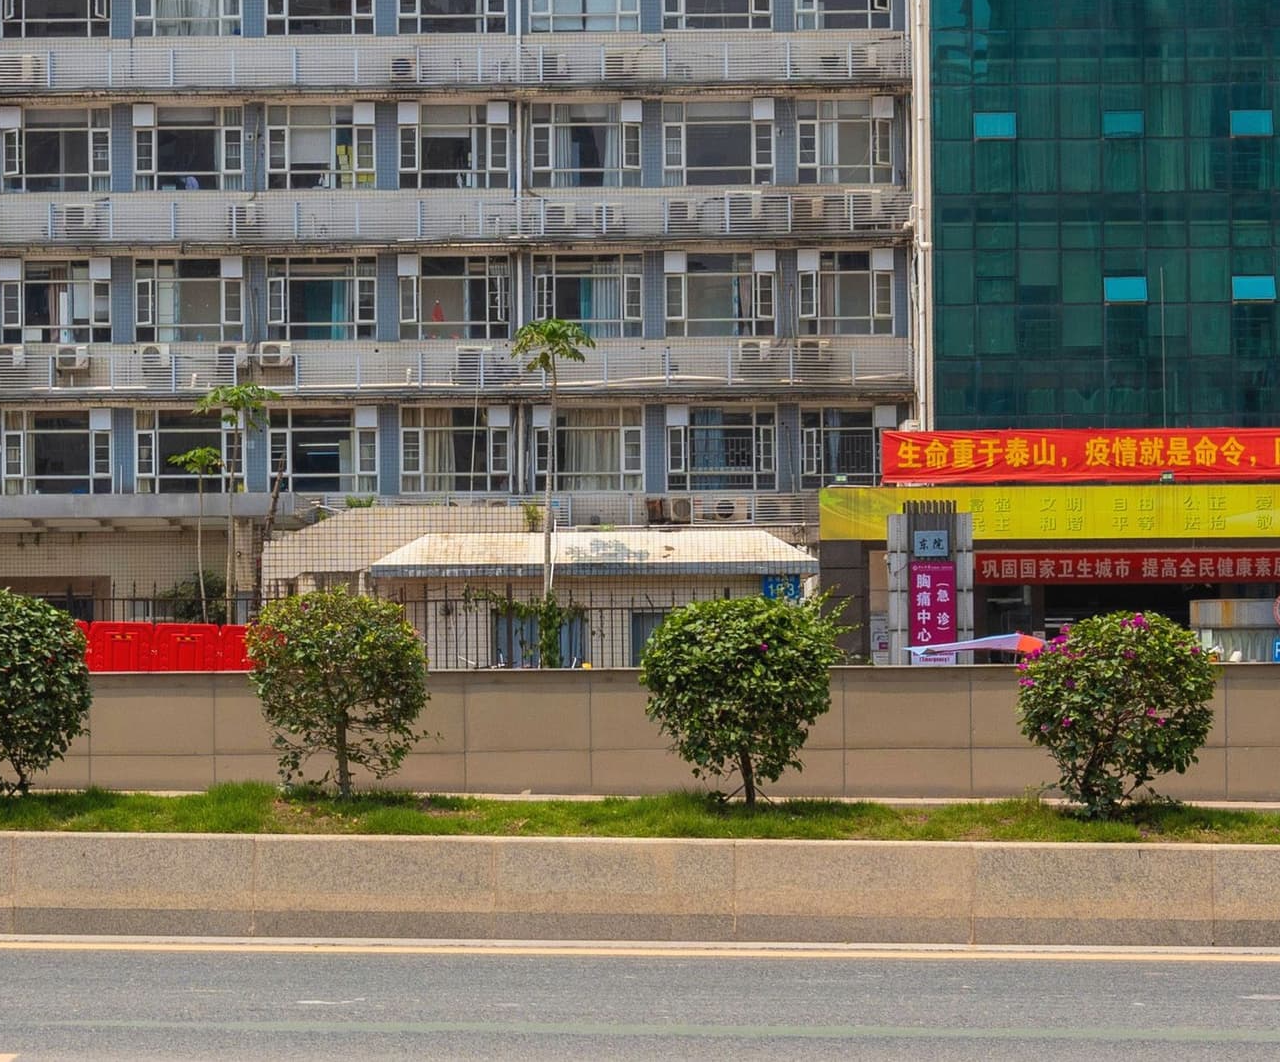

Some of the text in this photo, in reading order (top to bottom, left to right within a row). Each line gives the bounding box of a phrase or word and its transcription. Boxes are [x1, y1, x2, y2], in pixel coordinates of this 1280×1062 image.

[1040, 497, 1083, 512] 文明
[1112, 497, 1154, 512] 自由
[1183, 496, 1227, 511] 公正
[1040, 516, 1083, 532] 和谐
[1112, 516, 1155, 531] 平等
[1183, 515, 1227, 531] 法治
[982, 558, 1131, 579] 巩固国家卫生城市
[916, 573, 932, 642] 胸痛中心
